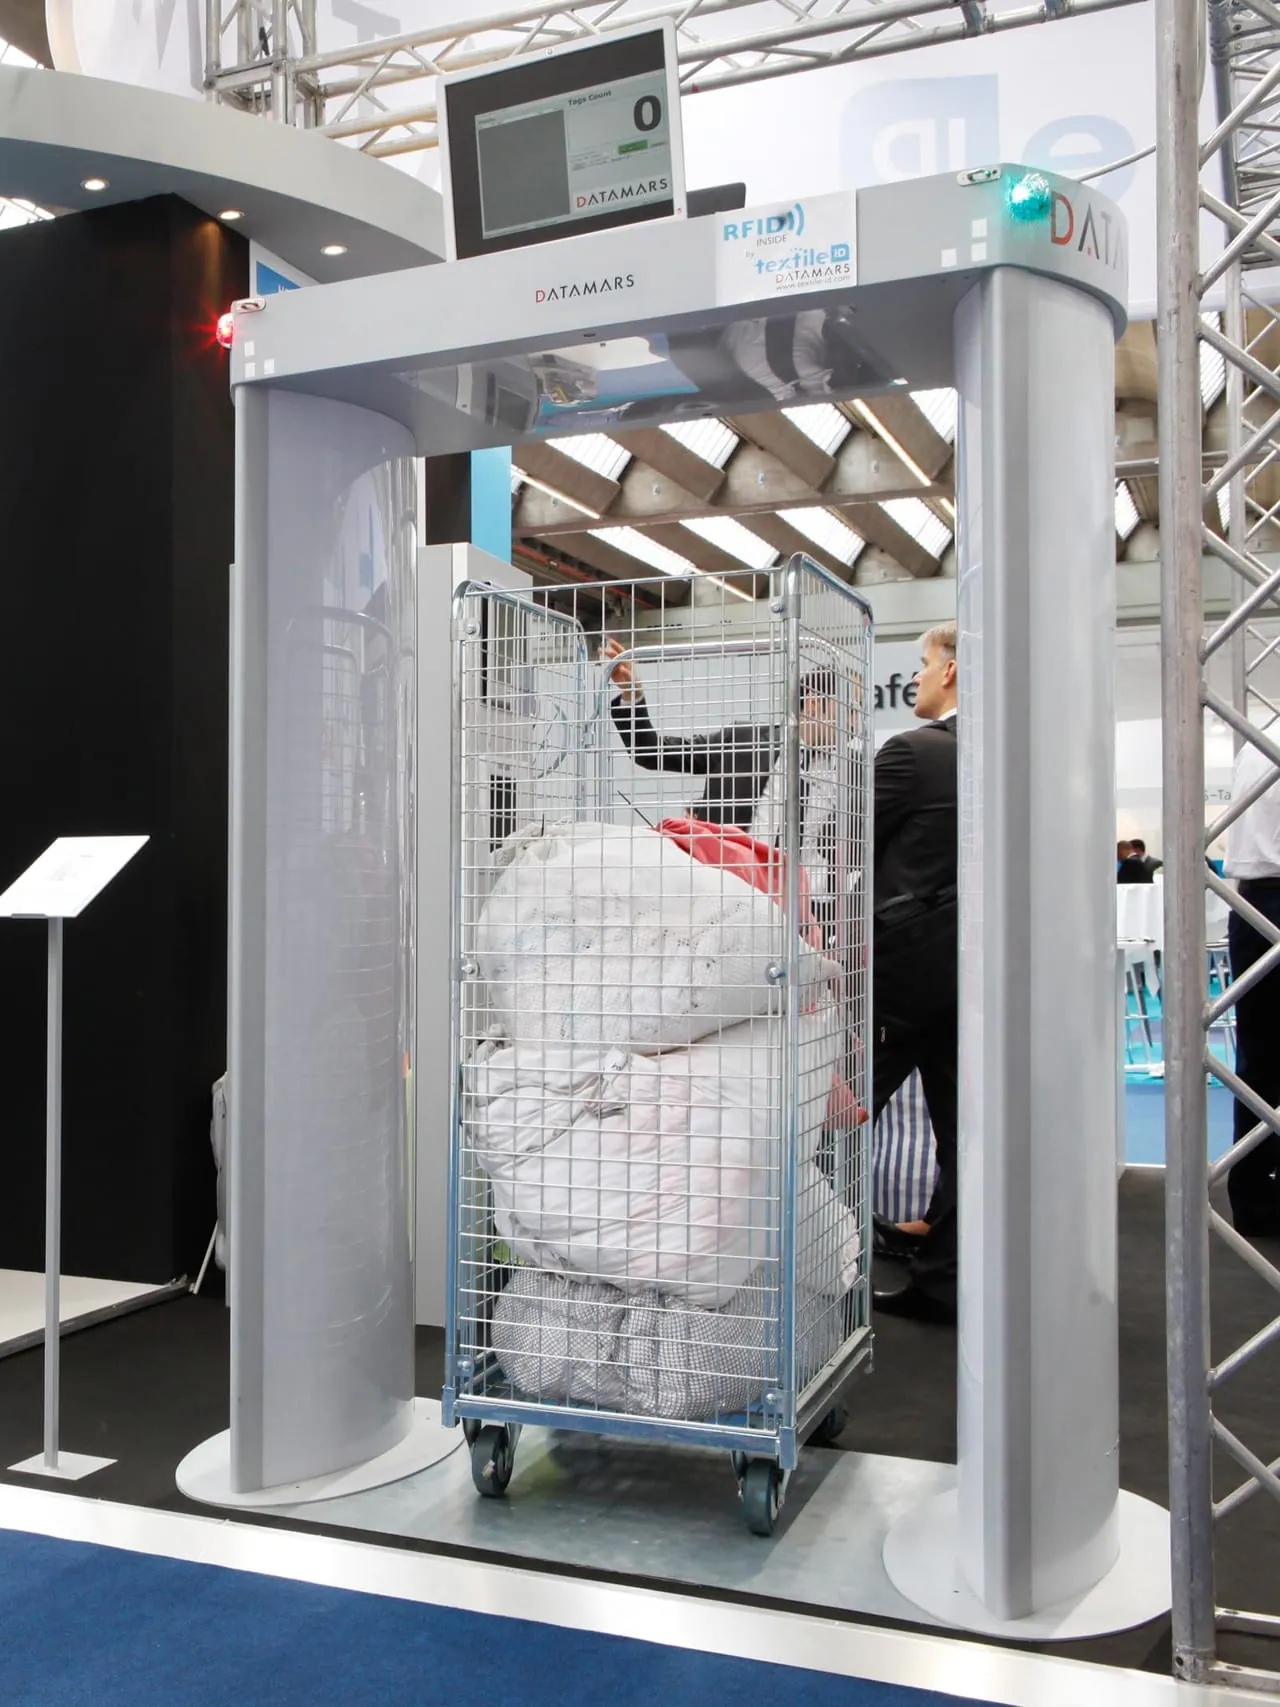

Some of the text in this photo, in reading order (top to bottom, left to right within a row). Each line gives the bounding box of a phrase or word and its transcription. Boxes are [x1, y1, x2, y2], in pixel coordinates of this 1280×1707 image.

[568, 90, 612, 106] Tags Count
[633, 95, 662, 132] 0
[576, 178, 668, 208] DATAMARS
[723, 215, 787, 241] RFID
[756, 234, 788, 247] INSIDE
[746, 251, 755, 259] by
[755, 248, 829, 275] textile
[776, 263, 850, 284] DATAMARS
[536, 274, 635, 303] DATAMARS
